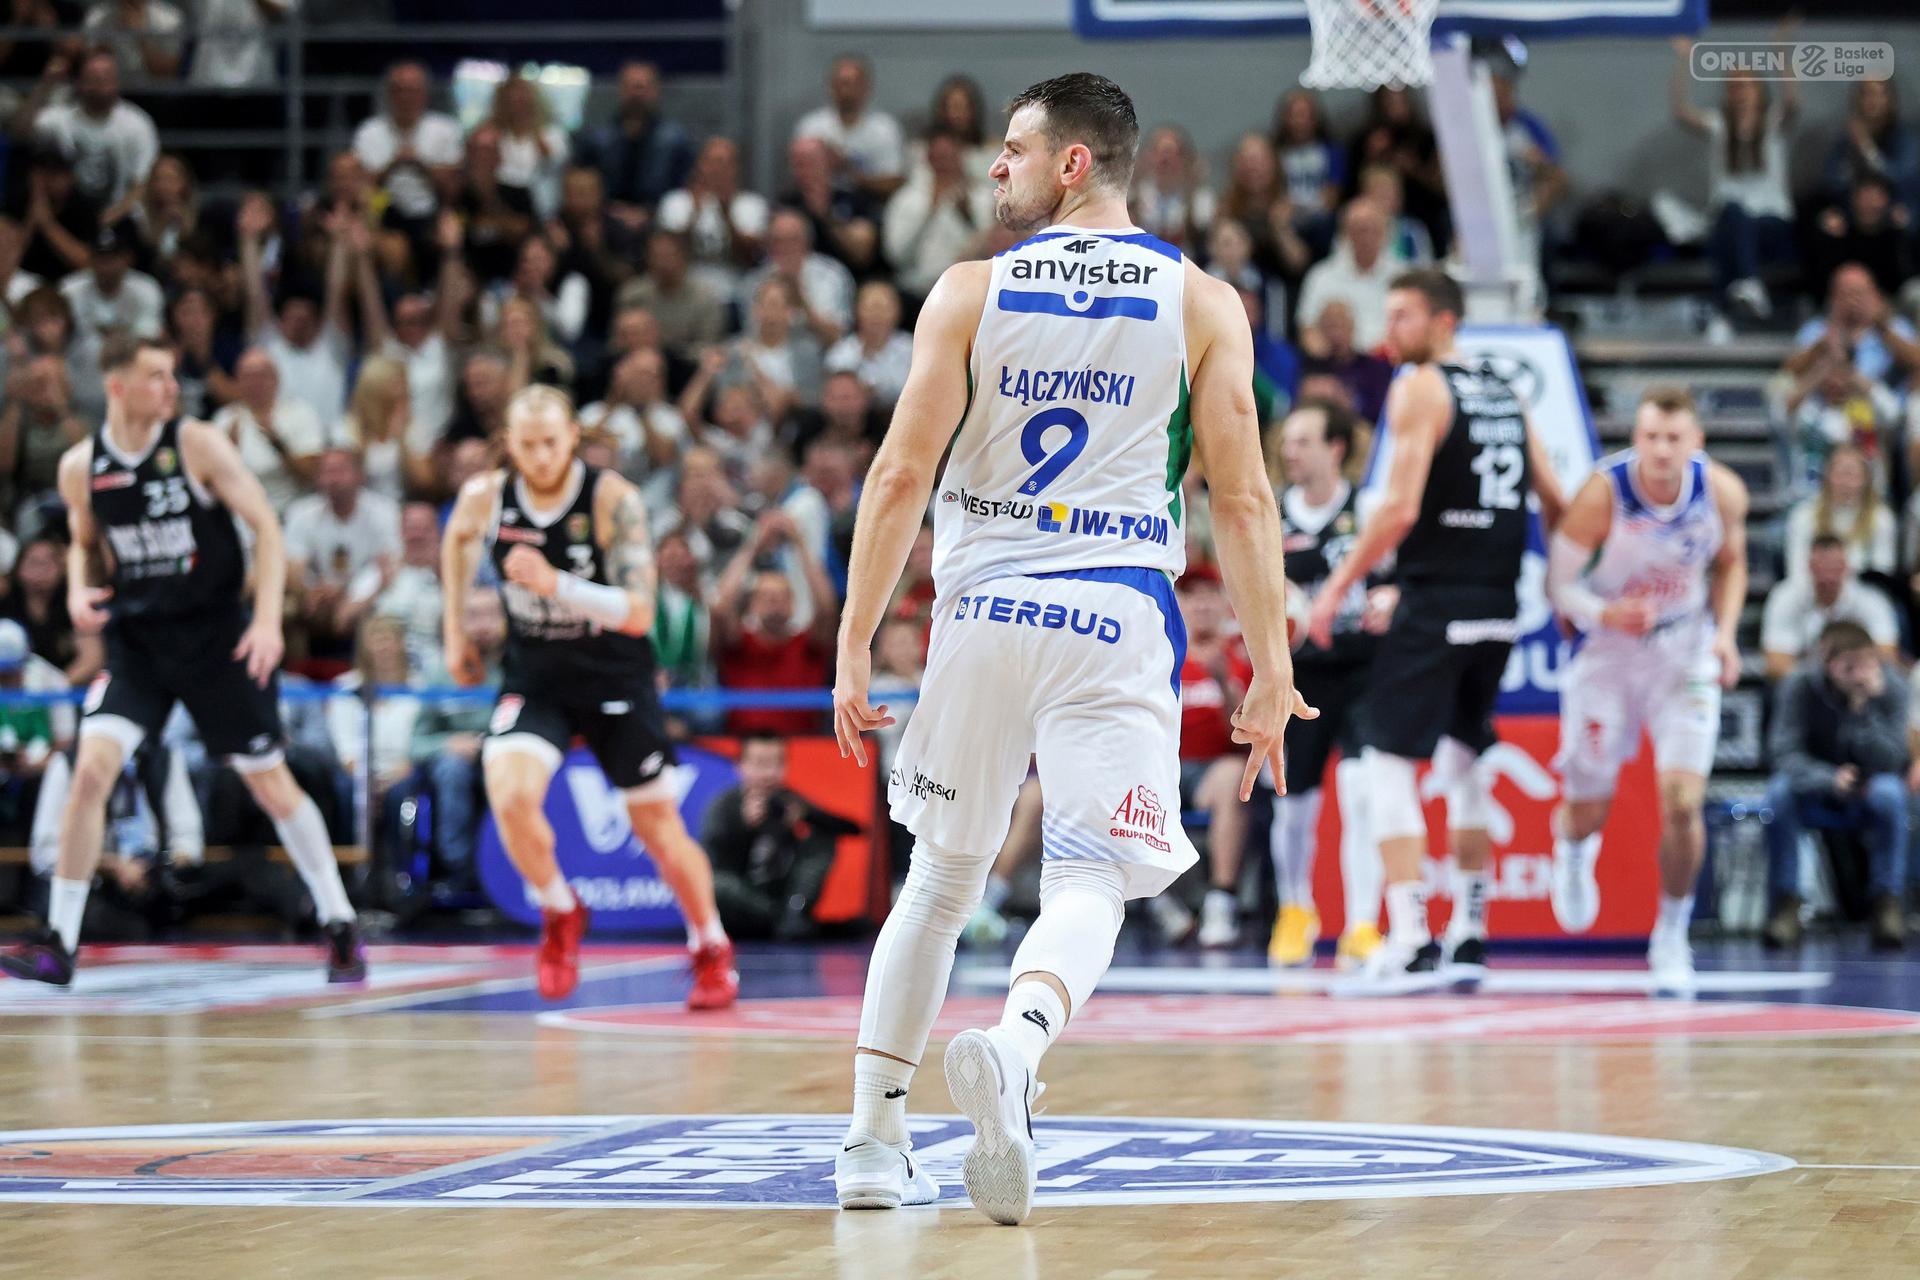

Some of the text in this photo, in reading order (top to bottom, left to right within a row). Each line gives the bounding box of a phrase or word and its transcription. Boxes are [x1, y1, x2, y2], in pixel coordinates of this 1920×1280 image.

[1063, 239, 1100, 254] 4F
[1011, 259, 1158, 286] anvistar
[999, 363, 1136, 407] ŁĄCZYŃSKI
[1016, 407, 1090, 497] 9
[1470, 445, 1525, 510] 12
[1069, 508, 1169, 546] IW-TOM
[972, 595, 1122, 645] TERBUD
[1110, 788, 1167, 836] Anwil
[1109, 828, 1145, 841] GRUPA
[1031, 1008, 1051, 1028] NIKE
